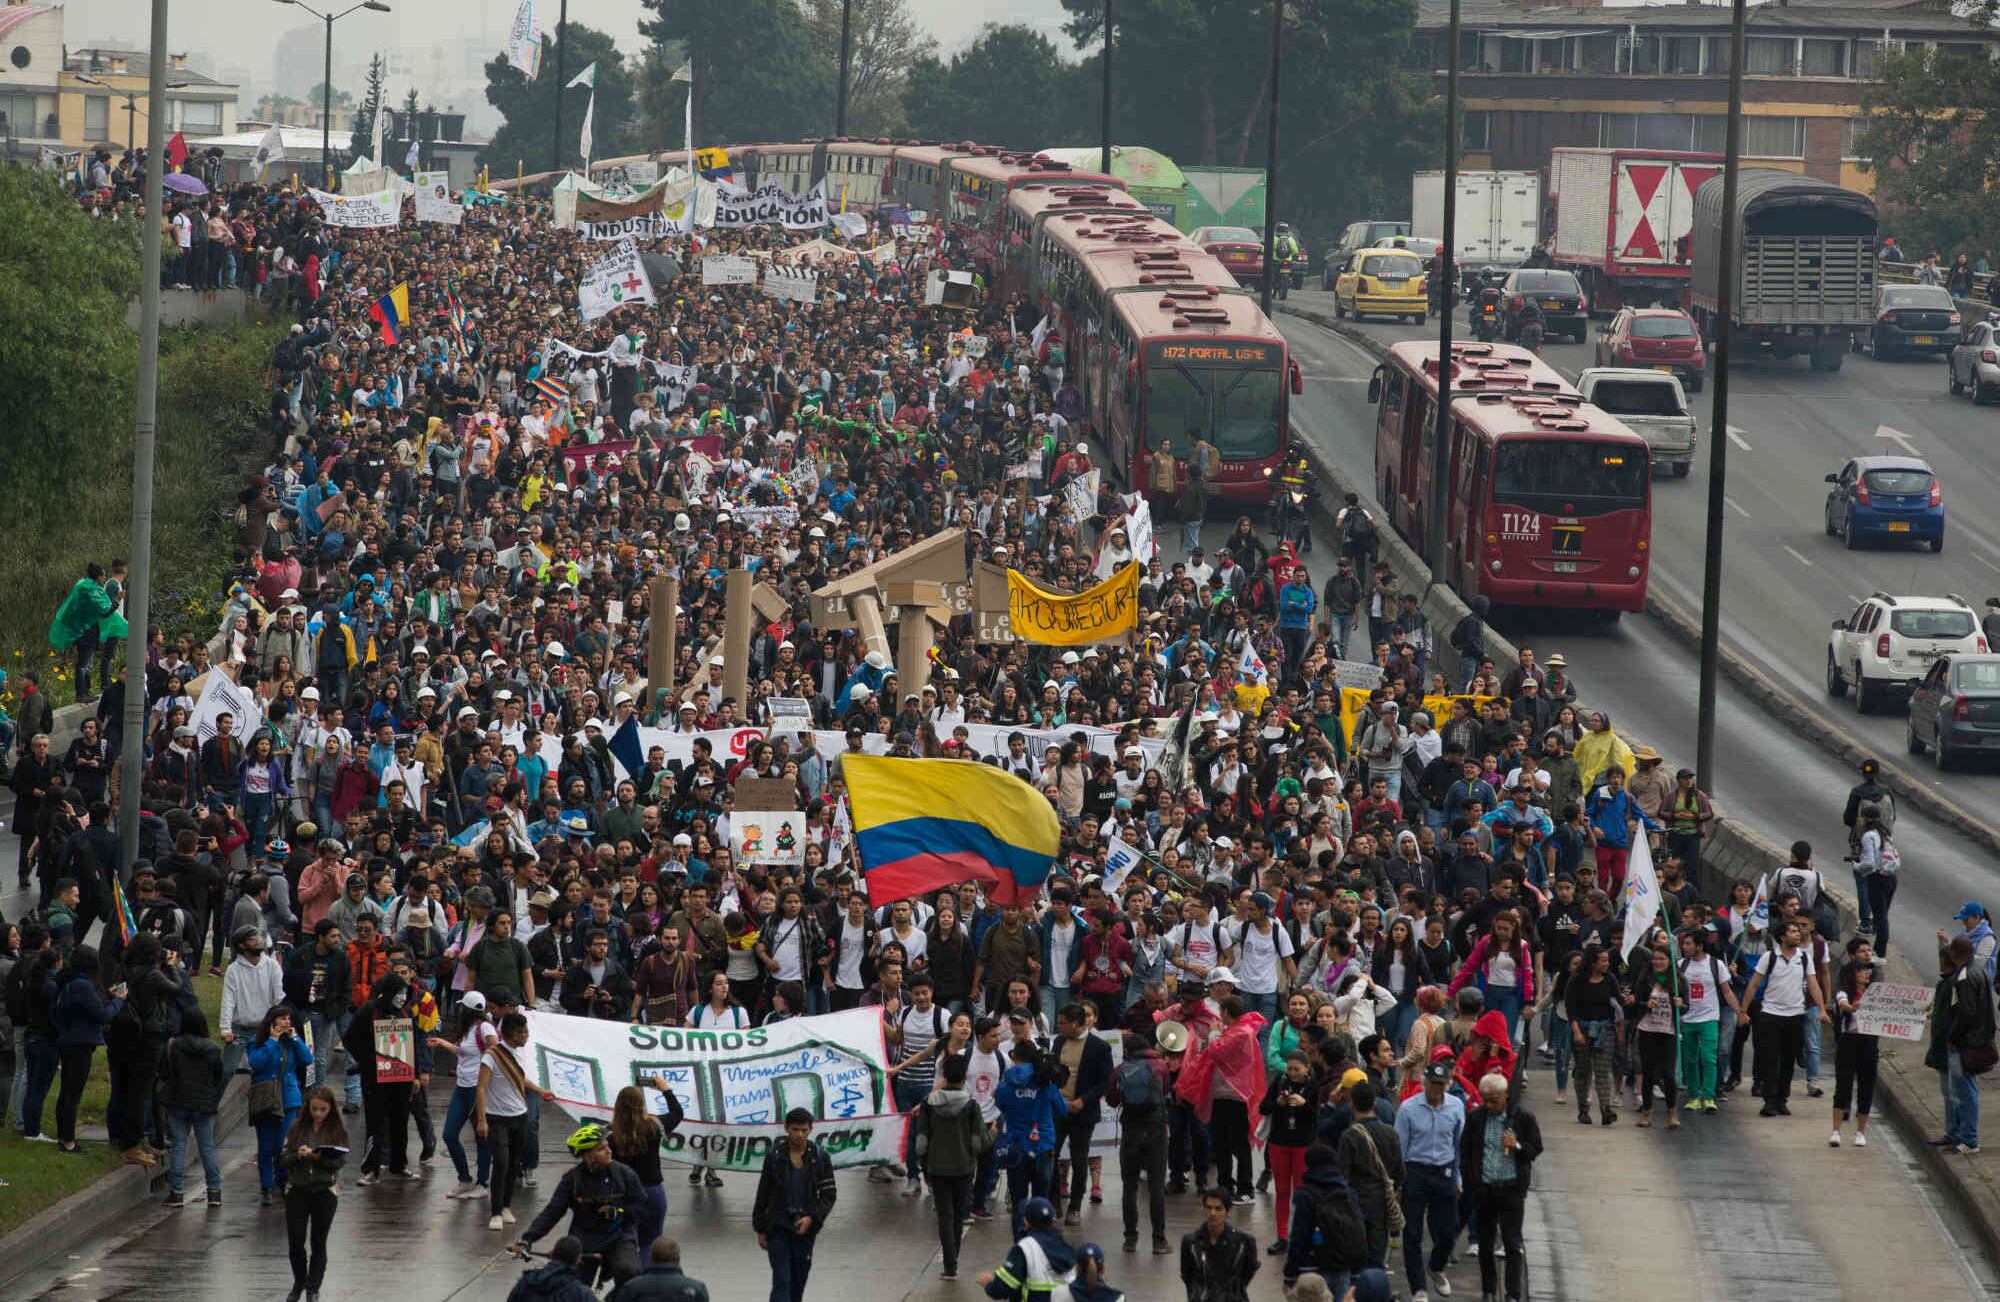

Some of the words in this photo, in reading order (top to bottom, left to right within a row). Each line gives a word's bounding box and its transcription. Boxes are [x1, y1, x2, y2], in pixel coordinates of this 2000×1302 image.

[1189, 347, 1232, 359] PORTAL
[1503, 514, 1540, 533] T124
[629, 1025, 768, 1051] Somos
[663, 1069, 689, 1083] PAZ
[1015, 1088, 1037, 1099] City
